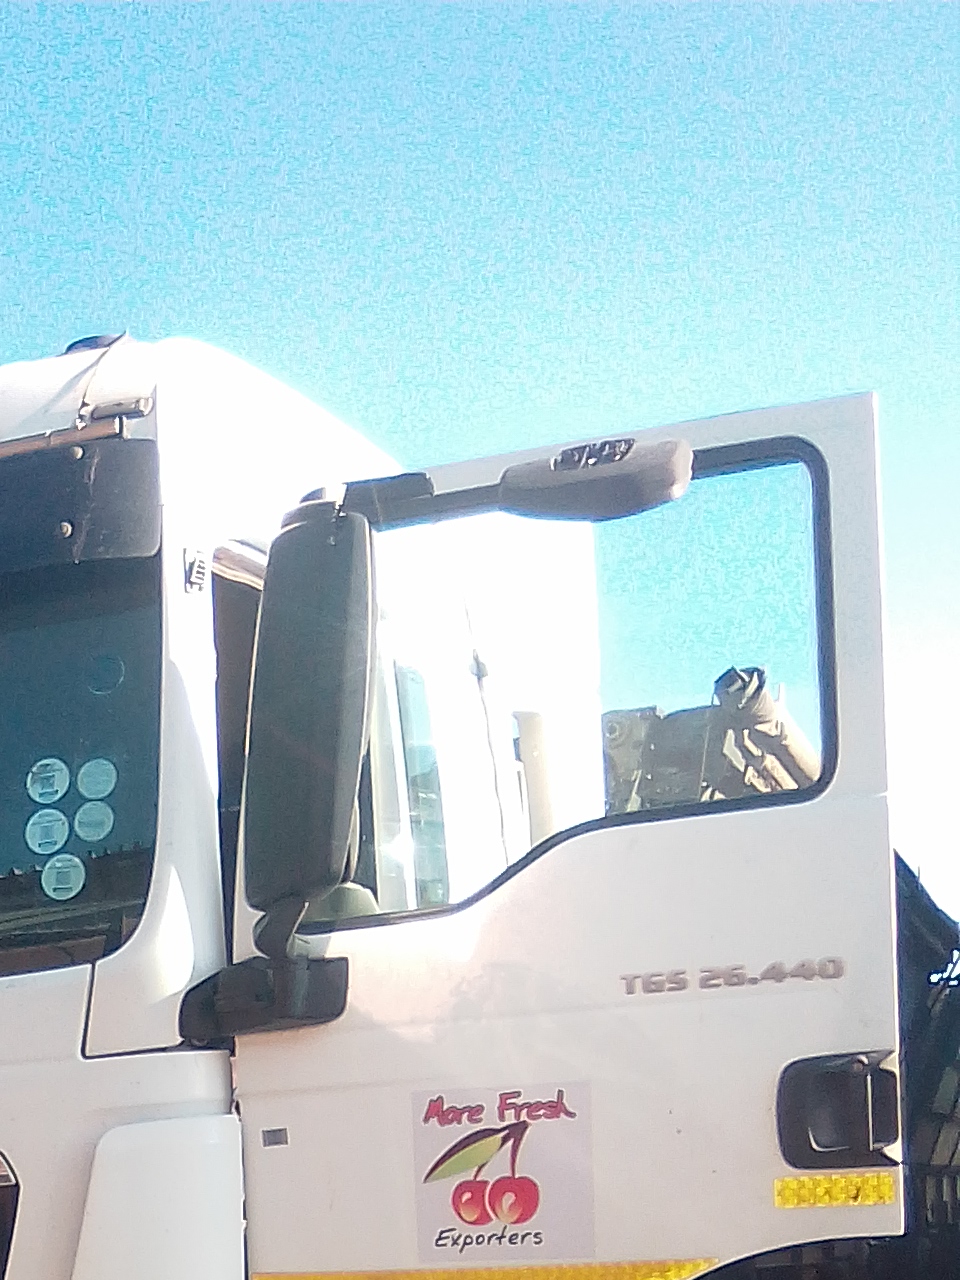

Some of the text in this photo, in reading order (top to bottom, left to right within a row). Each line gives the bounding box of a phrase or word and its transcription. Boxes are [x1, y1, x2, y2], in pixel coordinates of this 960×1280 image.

[620, 956, 846, 995] TGS 26.440
[423, 1089, 577, 1126] More Fresh
[435, 1225, 543, 1253] Exporters
